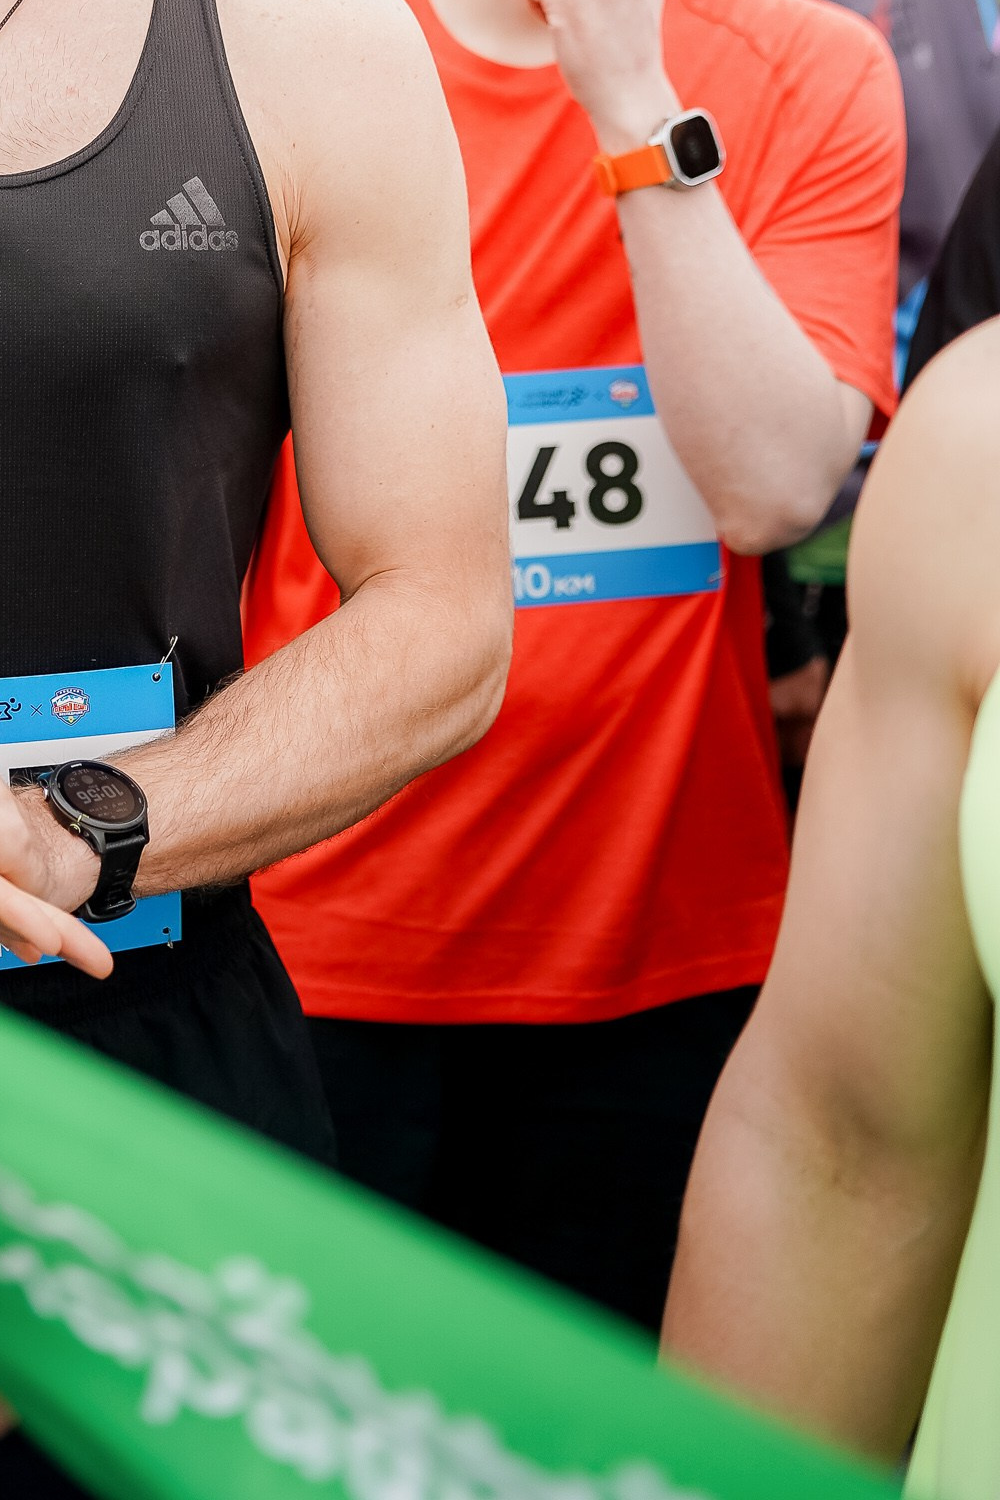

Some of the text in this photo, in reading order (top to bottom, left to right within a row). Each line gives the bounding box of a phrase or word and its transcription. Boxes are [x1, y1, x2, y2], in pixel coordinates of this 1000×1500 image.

[139, 223, 239, 251] adidas
[517, 441, 643, 529] 48
[513, 563, 551, 601] 10
[76, 783, 124, 805] 10:56
